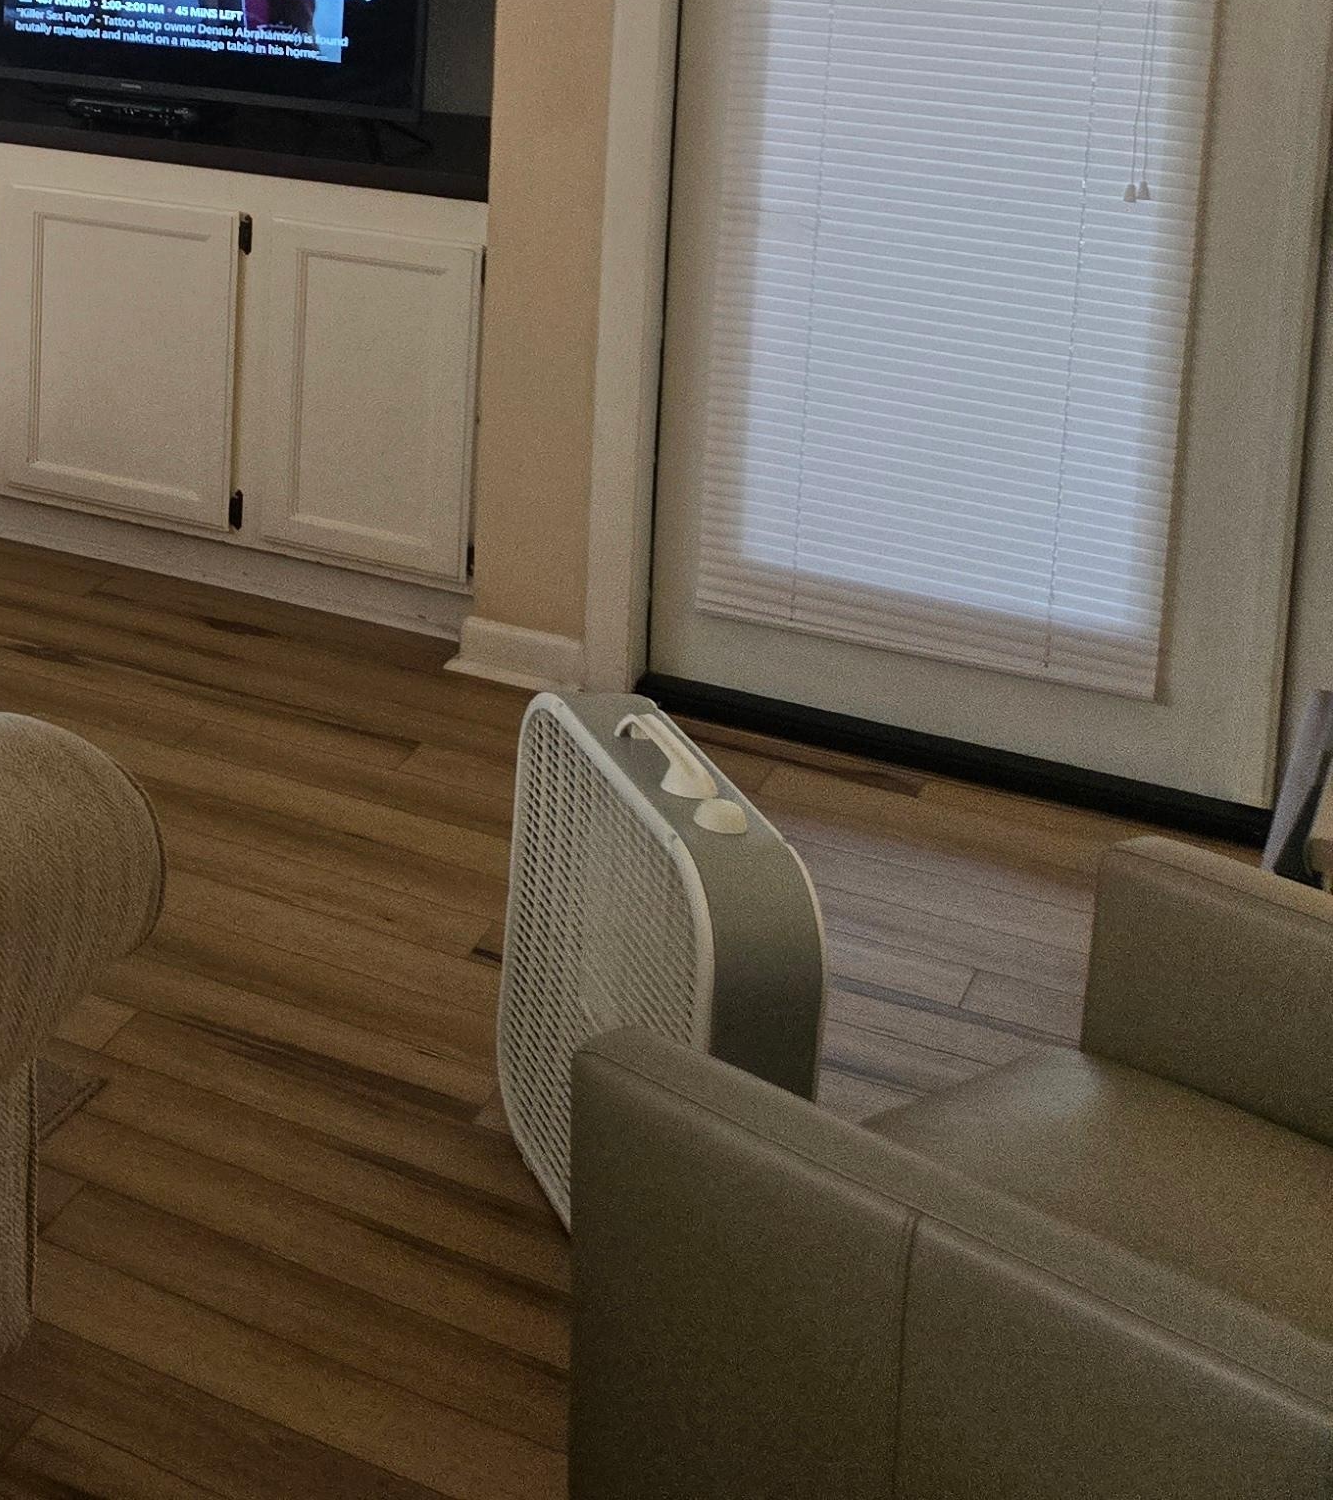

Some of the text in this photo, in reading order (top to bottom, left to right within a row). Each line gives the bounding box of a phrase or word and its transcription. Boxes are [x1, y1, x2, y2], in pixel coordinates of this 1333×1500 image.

[46, 10, 63, 21] Sex
[103, 14, 135, 28] Tattoo
[137, 18, 162, 32] shop
[164, 22, 196, 34] owner
[198, 23, 233, 37] Dennis
[304, 32, 313, 44] is
[314, 35, 349, 47] found
[147, 3, 164, 14] PM
[175, 5, 189, 17] 45
[190, 7, 218, 19] MINS
[219, 9, 244, 21] LEFT
[15, 20, 52, 35] brutally
[53, 26, 101, 38] murdered
[102, 30, 121, 40] and
[122, 30, 154, 44] naked
[155, 36, 170, 45] on
[180, 37, 225, 51] massage
[227, 40, 254, 53] table
[256, 42, 267, 55] in
[268, 43, 284, 55] his
